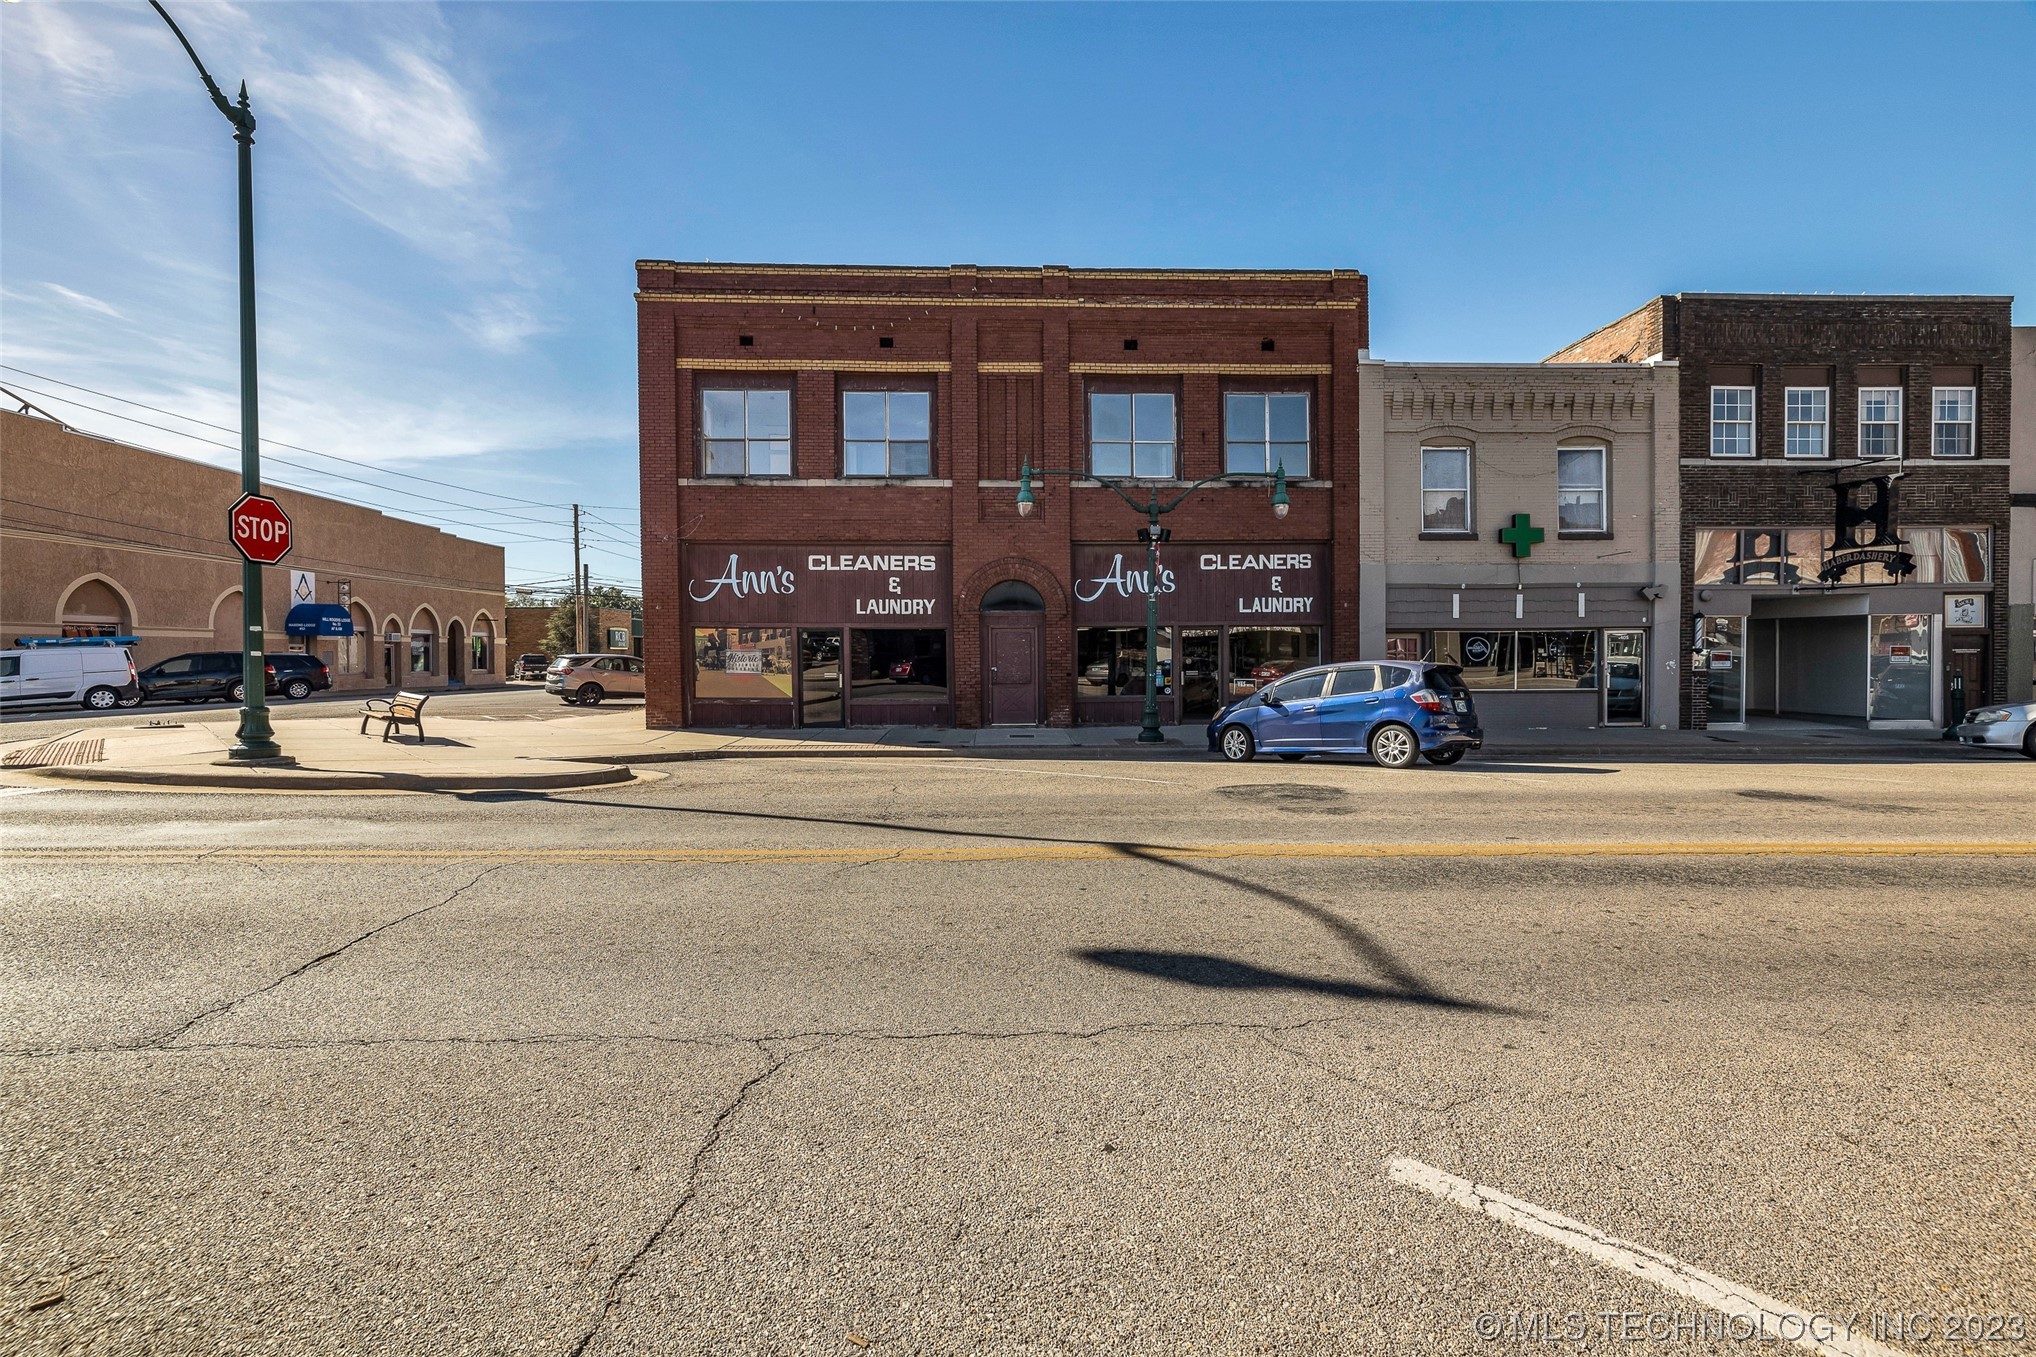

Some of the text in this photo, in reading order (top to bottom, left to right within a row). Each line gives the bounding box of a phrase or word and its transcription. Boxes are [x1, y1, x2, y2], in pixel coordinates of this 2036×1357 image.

[237, 514, 287, 543] STOP
[808, 554, 936, 571] CLEANERS
[1199, 553, 1312, 570] CLEANERS
[1823, 551, 1897, 571] HABERDASHERY
[688, 553, 795, 602] Ann's
[888, 576, 902, 595] &
[1271, 576, 1283, 594] &
[855, 598, 936, 615] LAUNDRY
[1239, 596, 1314, 613] LAUNDRY
[615, 631, 625, 641] RCB
[727, 653, 759, 663] Historic
